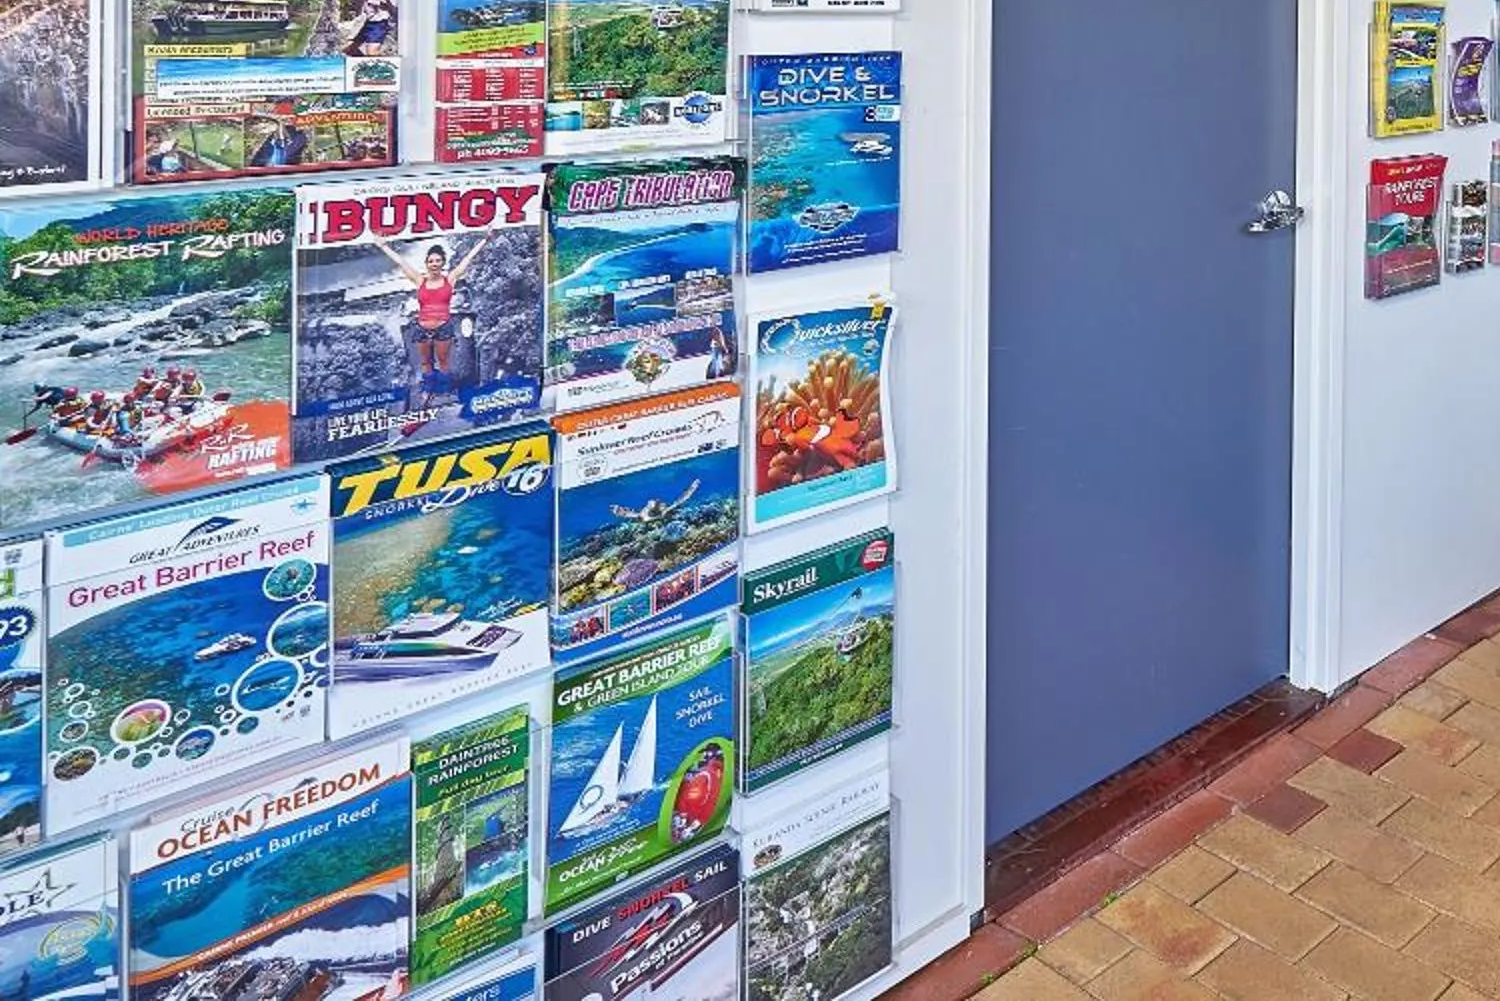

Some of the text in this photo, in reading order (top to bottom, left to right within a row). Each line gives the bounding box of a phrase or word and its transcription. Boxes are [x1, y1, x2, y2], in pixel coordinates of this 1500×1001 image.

[777, 66, 872, 86] DIVE &
[759, 84, 896, 108] SNORKEL
[567, 169, 736, 212] CAPE TRIBULATION
[73, 218, 229, 245] WORLD HERITAGE
[322, 185, 541, 244] BUNGY
[11, 228, 286, 280] RAINFOREST RAFTING
[327, 407, 441, 442] FEARLESSLY
[207, 440, 278, 471] RAFTING
[338, 434, 550, 519] TUSA
[420, 479, 499, 514] Dive
[67, 530, 317, 609] Great Barrier Reef
[752, 566, 819, 604] Skyrail
[557, 634, 721, 706] GREAT BARRIER REEF
[587, 682, 630, 708] GREEN
[631, 668, 675, 693] ISLAND
[675, 693, 726, 720] SNORKEL
[688, 686, 713, 702] SAIL
[688, 712, 713, 728] DIVE
[428, 744, 519, 786] RAINFOREST
[439, 734, 509, 770] DAINTREE
[157, 763, 382, 860] OCEAN FREEDOM
[180, 805, 236, 834] Cruise
[162, 798, 381, 896] The Great Barrier Reef
[559, 854, 605, 883] OCEAN
[572, 915, 612, 943] DIVE
[694, 860, 728, 882] SAIL
[609, 919, 703, 995] Passions
